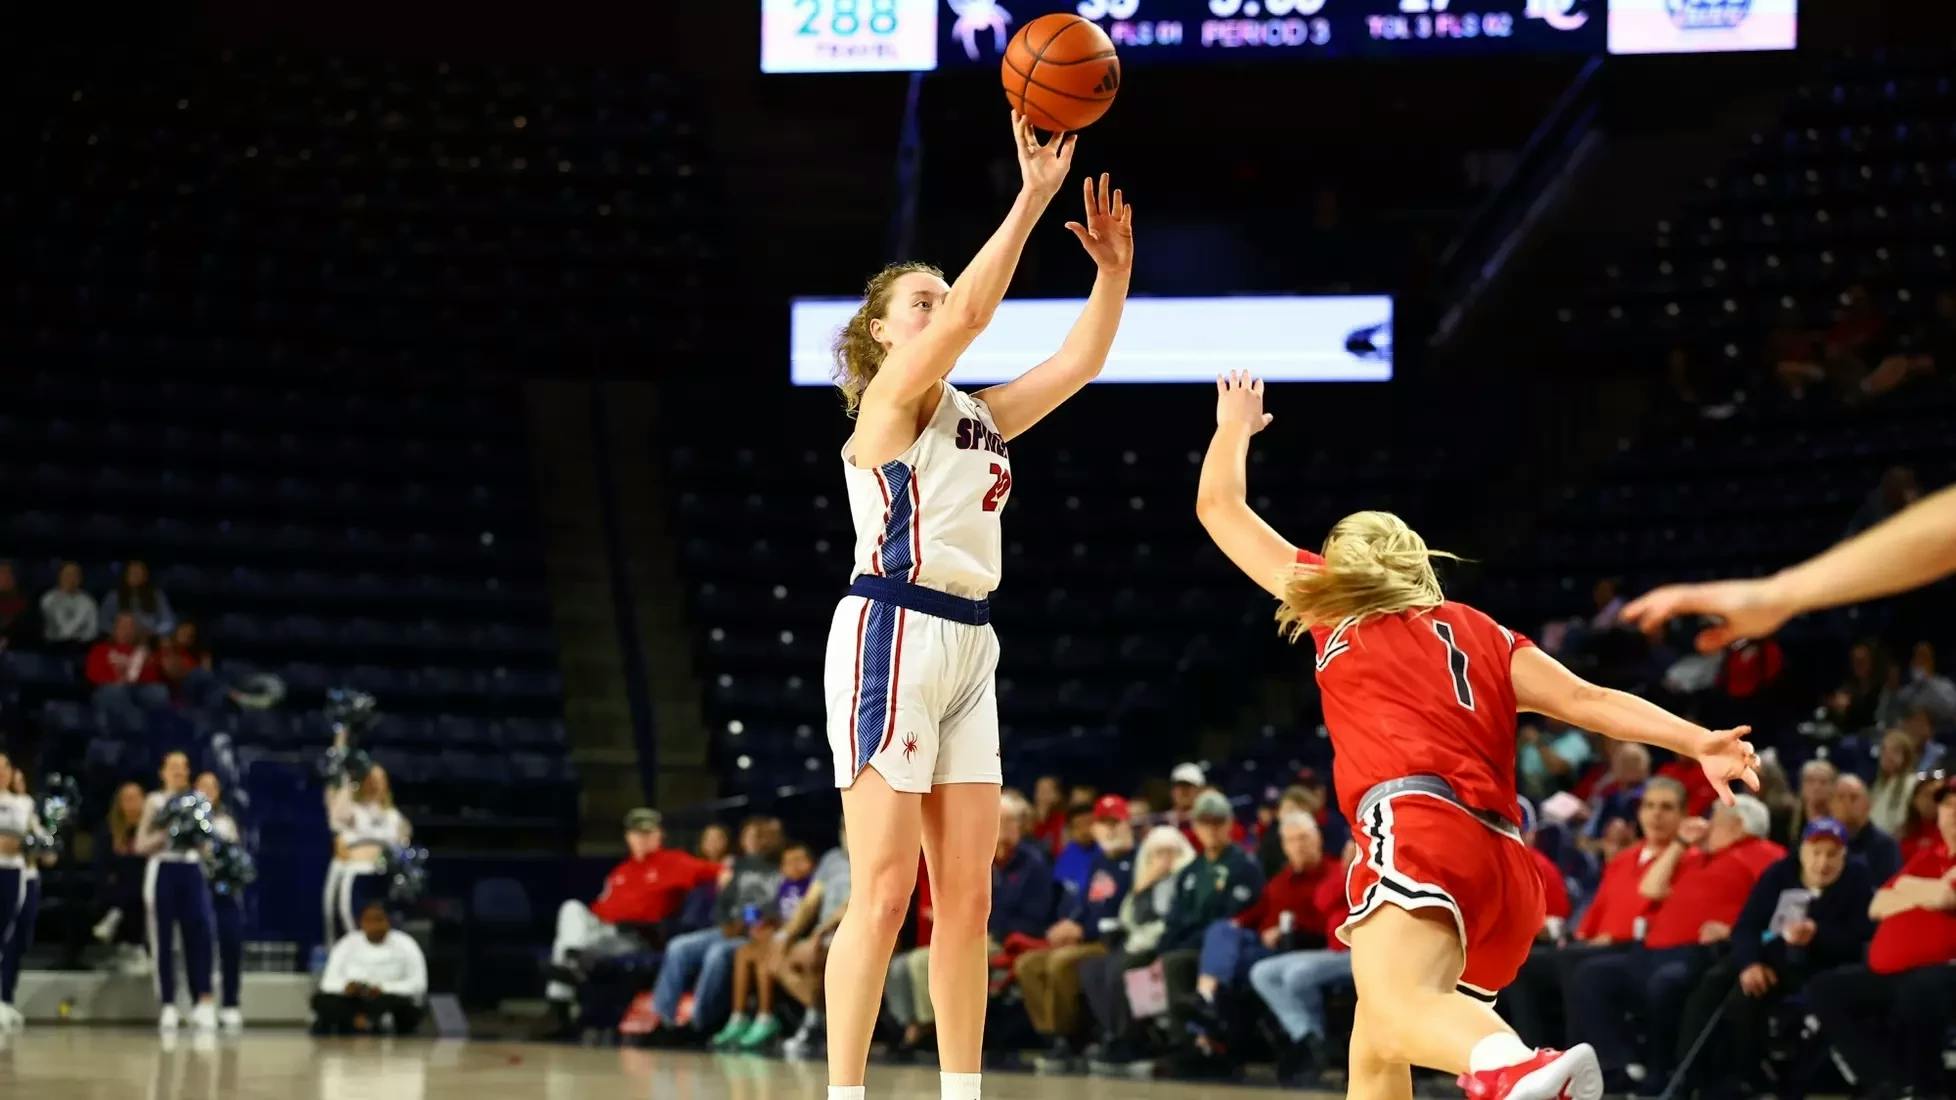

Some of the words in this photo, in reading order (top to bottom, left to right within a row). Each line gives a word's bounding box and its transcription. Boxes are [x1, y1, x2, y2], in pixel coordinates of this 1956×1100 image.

[794, 0, 898, 36] 288
[1201, 17, 1308, 48] PERIOD
[1309, 16, 1331, 46] 3
[1433, 619, 1475, 711] 1
